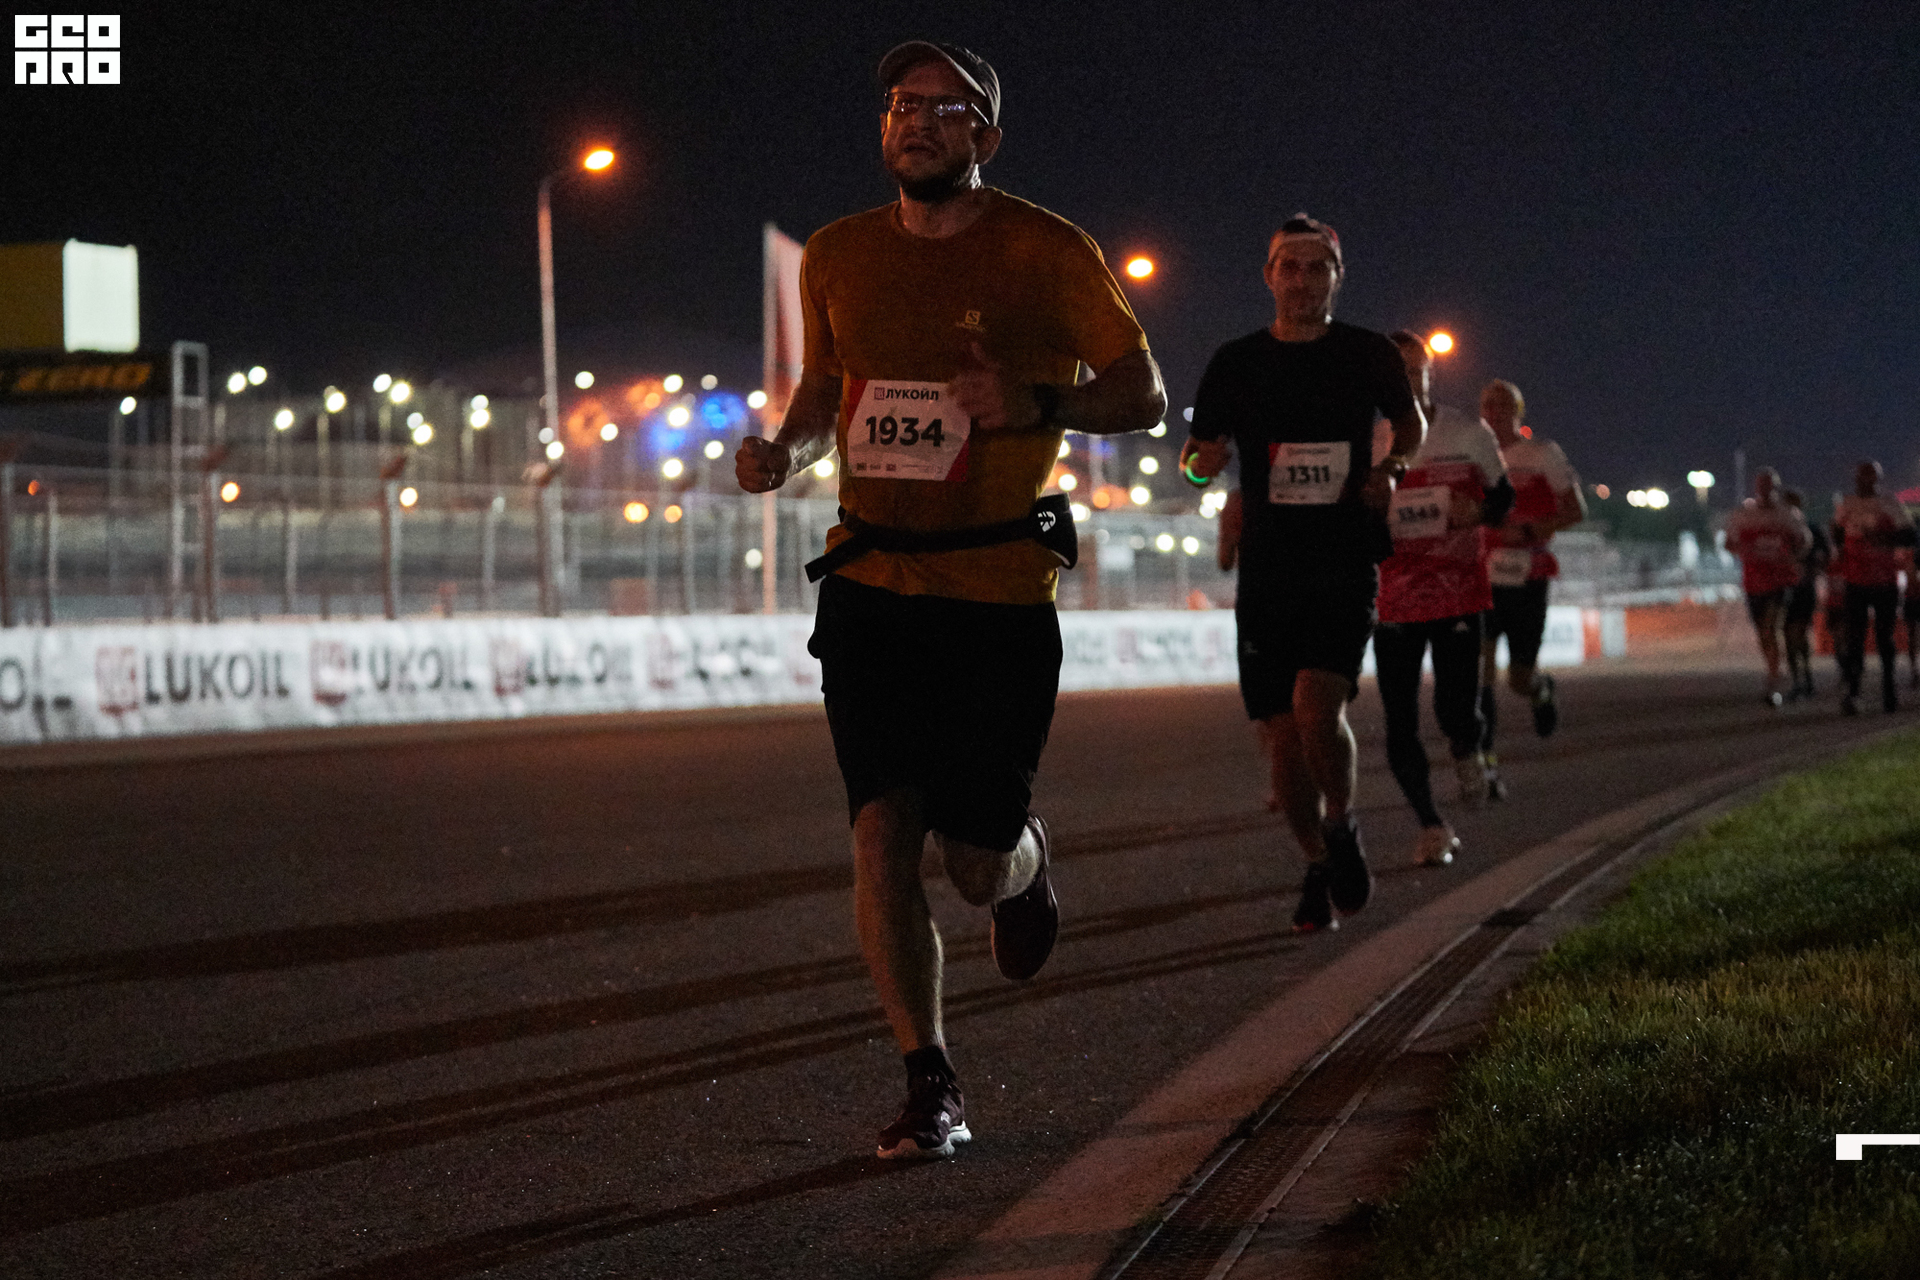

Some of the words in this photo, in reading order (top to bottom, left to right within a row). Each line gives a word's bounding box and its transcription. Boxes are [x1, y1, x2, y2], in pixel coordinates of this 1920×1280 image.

[885, 388, 939, 400] ЛУКОЙЛ
[866, 416, 945, 447] 1934
[1288, 465, 1330, 484] 1311
[145, 652, 289, 704] LUKOIL
